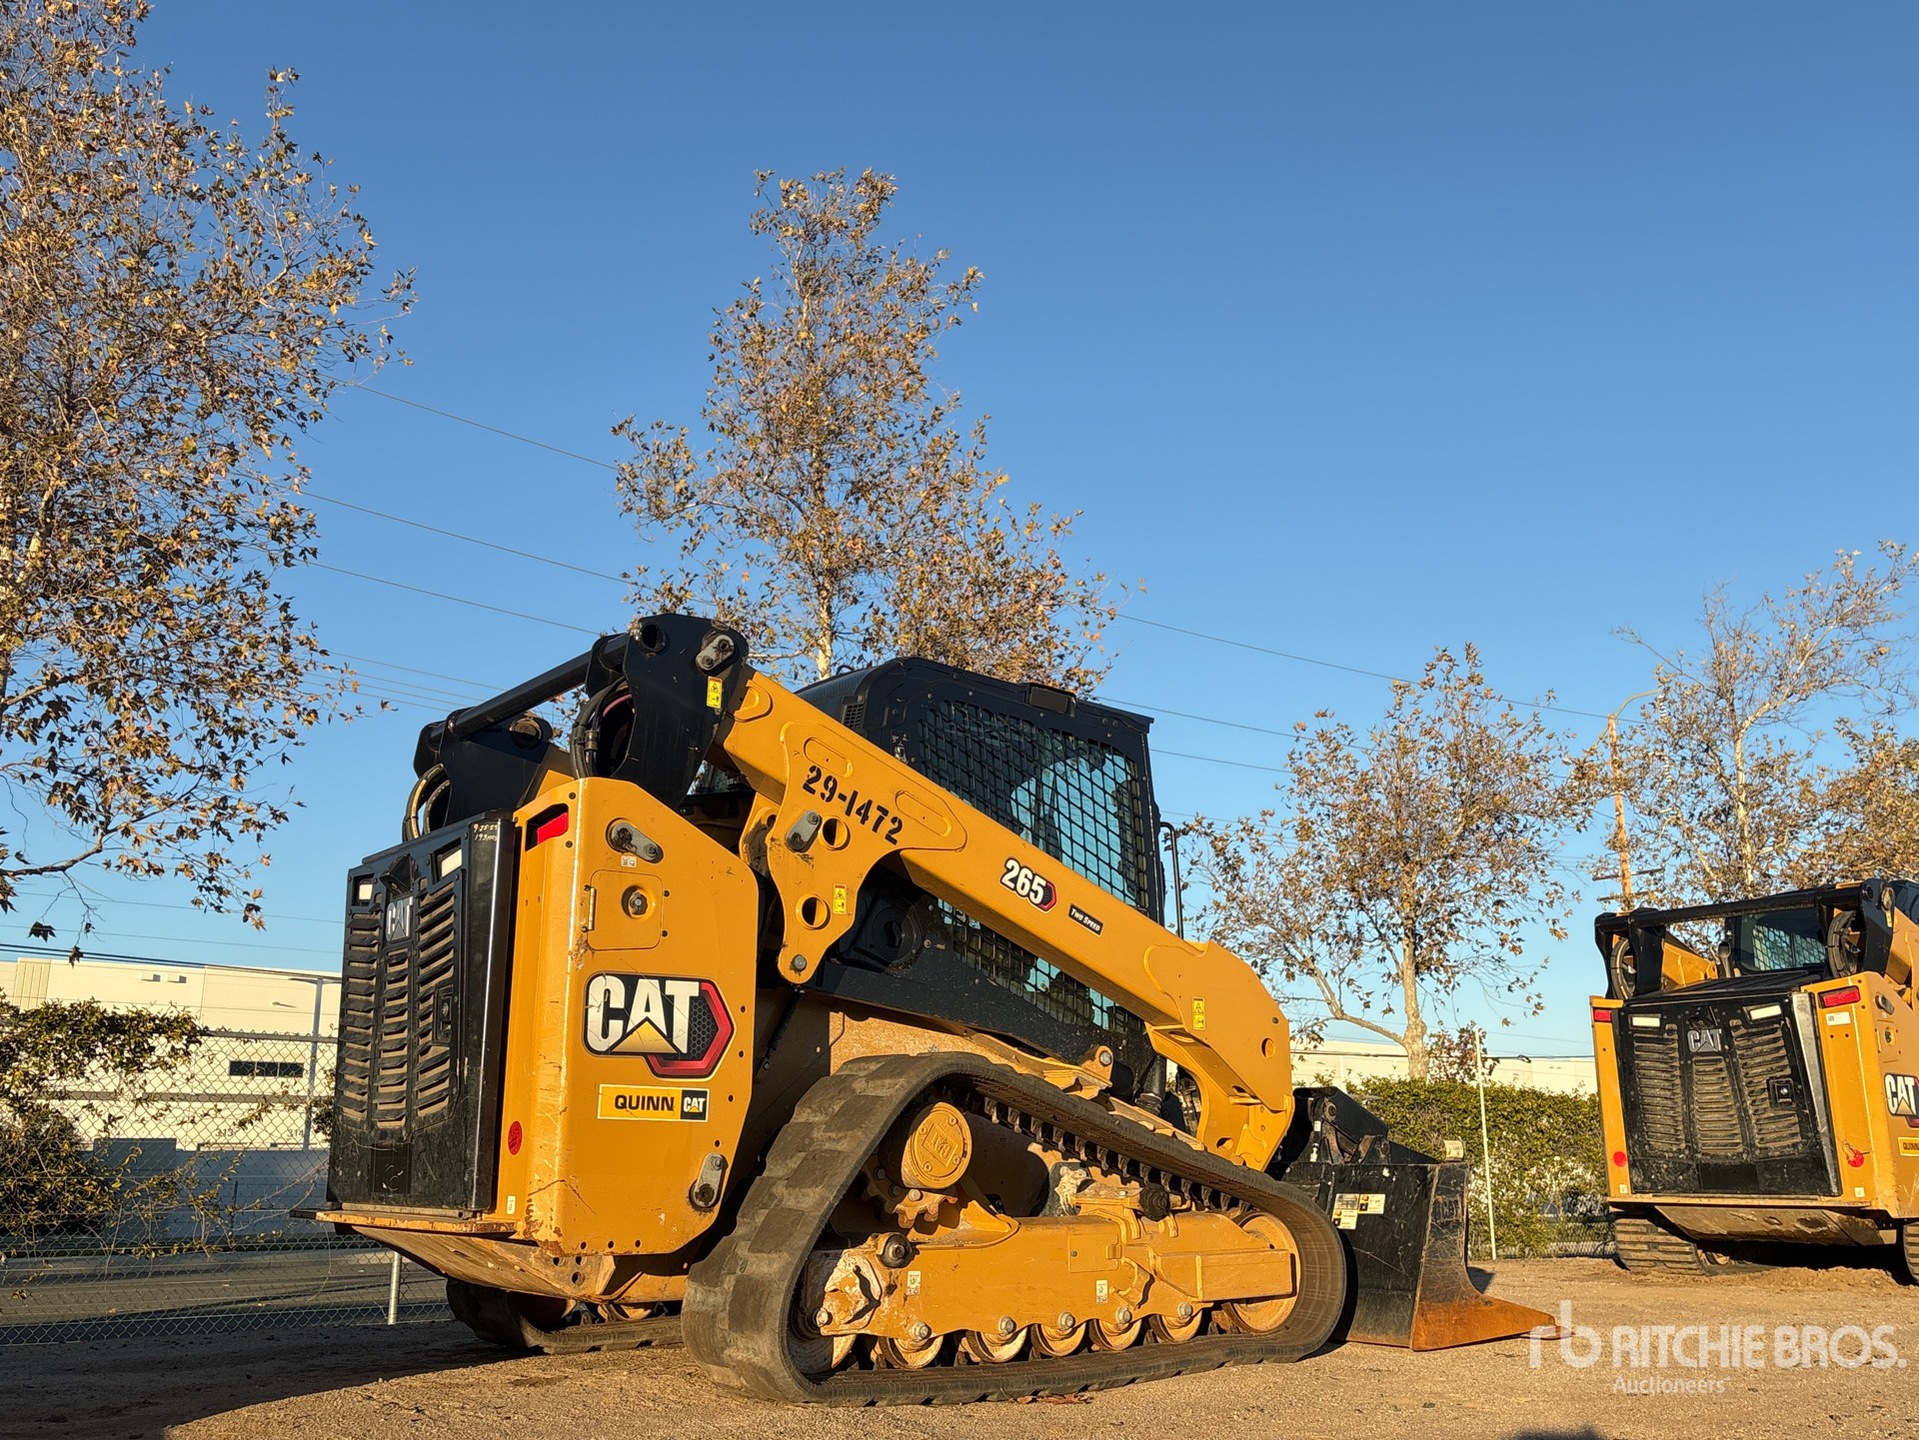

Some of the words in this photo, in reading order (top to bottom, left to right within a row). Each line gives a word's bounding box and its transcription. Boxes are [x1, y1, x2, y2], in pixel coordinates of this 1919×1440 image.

[802, 765, 903, 846] 29-1472
[1000, 858, 1048, 905] 265
[386, 895, 414, 942] CAT
[587, 975, 700, 1054] CAT
[1687, 1028, 1722, 1053] CAT
[614, 1094, 675, 1112] QUINN
[683, 1096, 706, 1113] CAT
[1884, 1074, 1917, 1116] CAT
